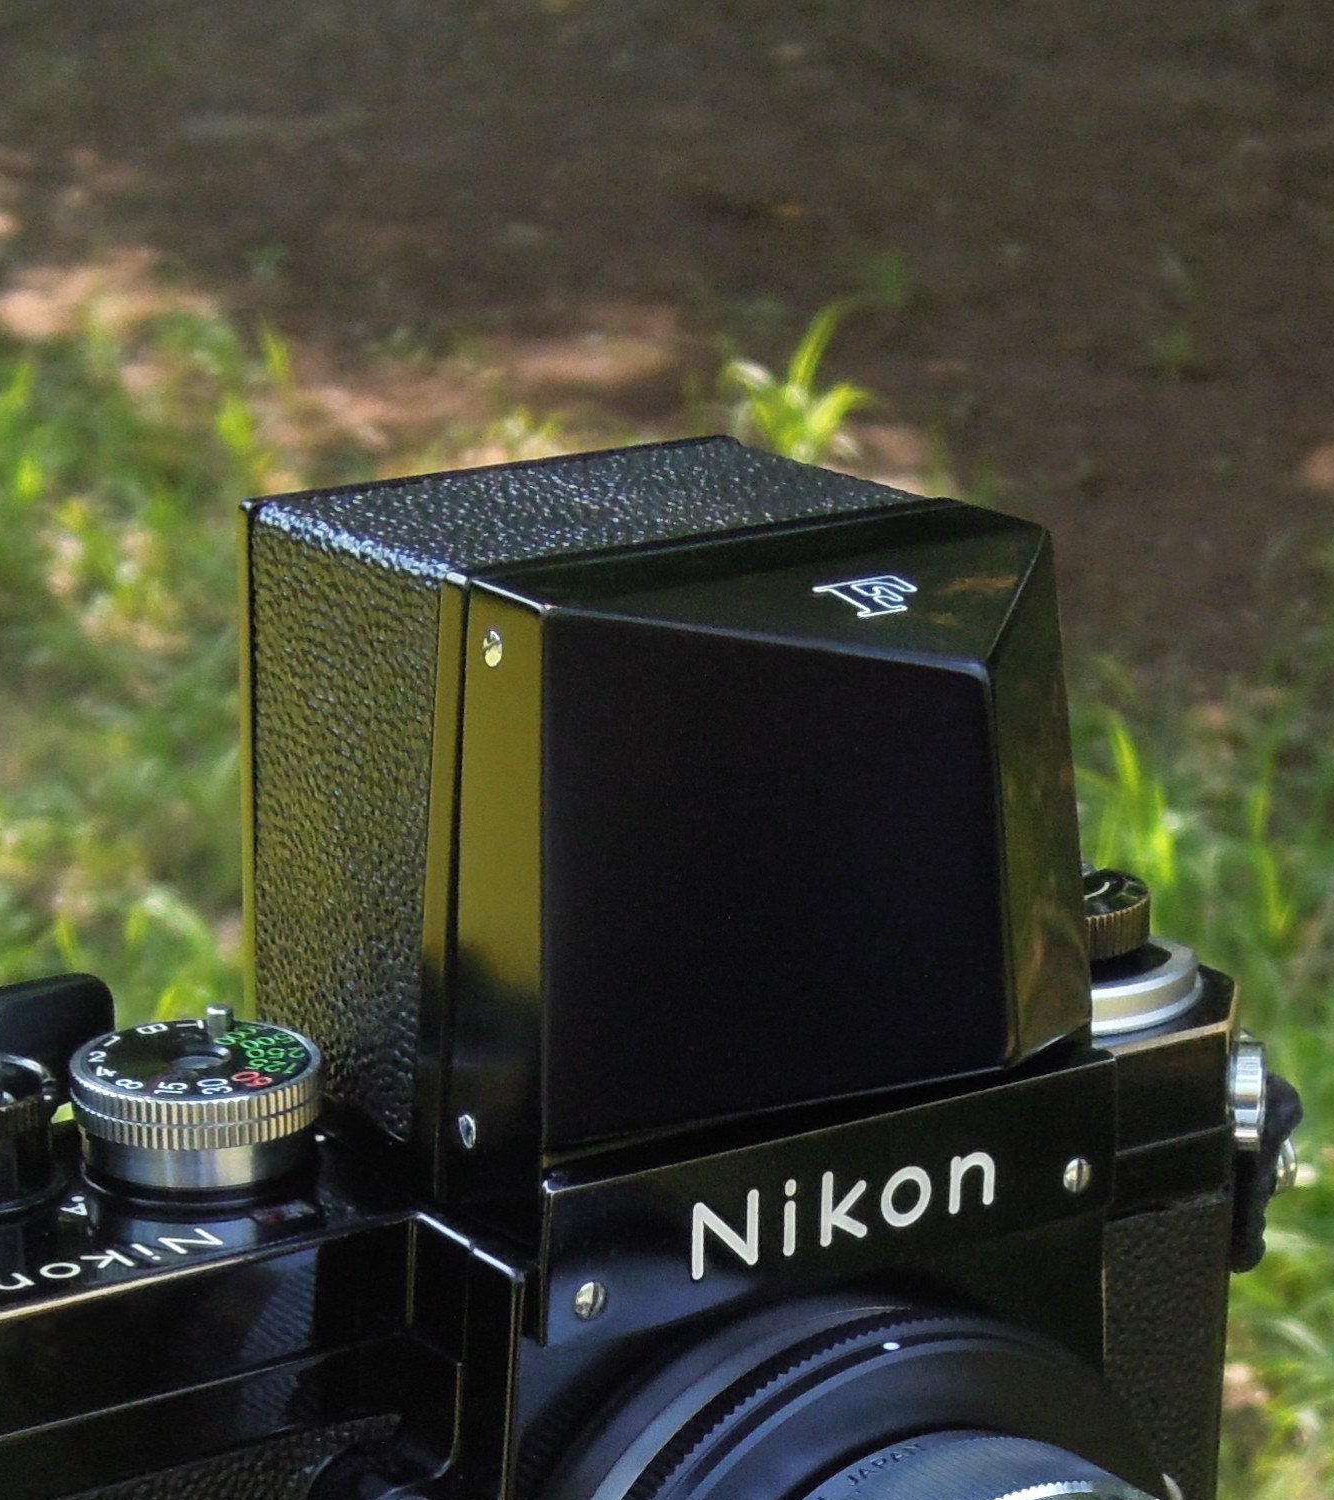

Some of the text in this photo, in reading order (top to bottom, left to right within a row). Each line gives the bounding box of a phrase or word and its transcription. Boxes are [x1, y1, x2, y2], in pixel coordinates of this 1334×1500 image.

[812, 575, 918, 617] F
[136, 1023, 169, 1035] B
[177, 1019, 204, 1030] T
[103, 1035, 121, 1047] 1
[88, 1051, 107, 1063] 2
[246, 1046, 306, 1059] 250
[95, 1066, 117, 1078] 4
[244, 1058, 297, 1074] 125
[115, 1078, 144, 1091] 8
[231, 1071, 273, 1088] 60
[154, 1082, 188, 1095] 15
[197, 1078, 233, 1095] 30
[691, 1151, 995, 1280] Nikon
[847, 1443, 926, 1486] JAPAN
